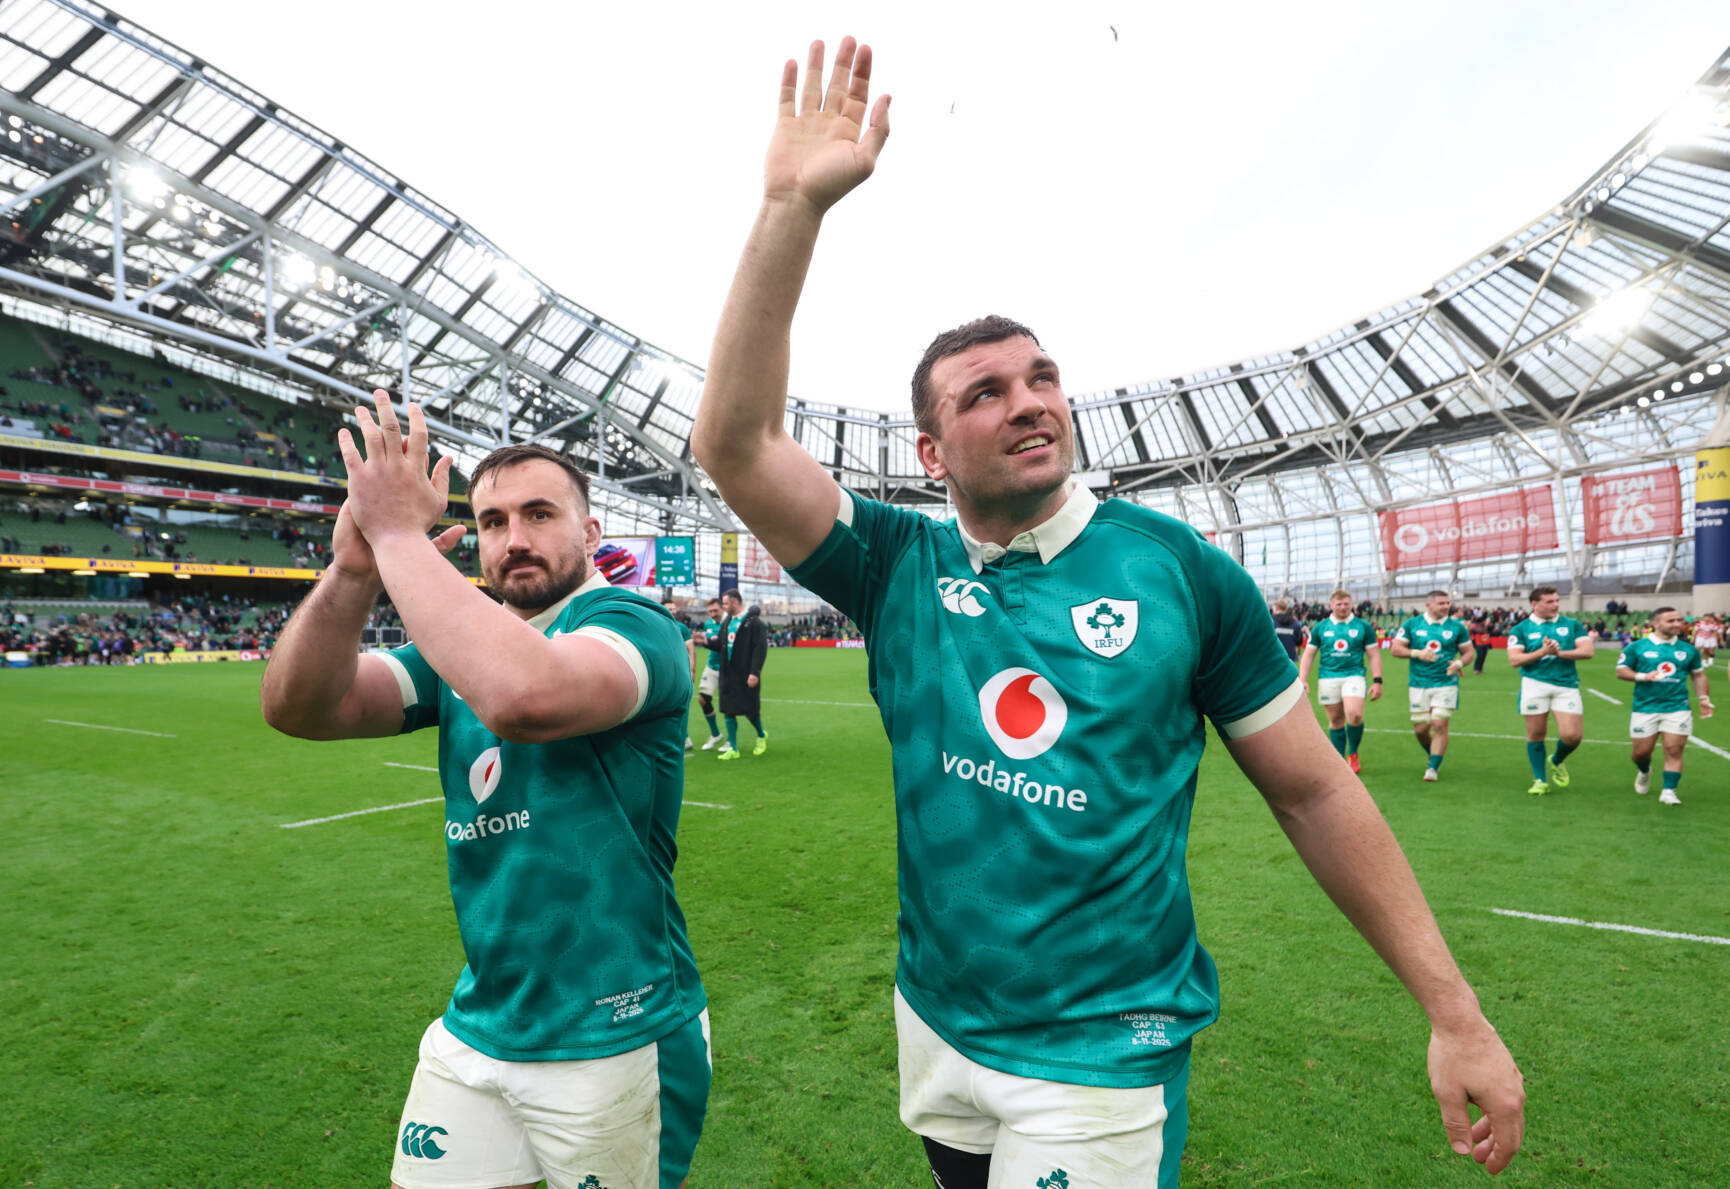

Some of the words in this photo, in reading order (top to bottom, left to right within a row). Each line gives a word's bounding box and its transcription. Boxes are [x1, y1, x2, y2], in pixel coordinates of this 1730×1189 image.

[1696, 471, 1728, 481] IVA
[1610, 503, 1656, 536] US
[1433, 512, 1541, 541] vodafone
[1094, 638, 1123, 648] IRFU
[942, 751, 1088, 812] vodafone
[595, 994, 621, 1006] RONAN
[613, 999, 629, 1007] CAP
[615, 1003, 639, 1015] JAPAN
[1149, 1013, 1177, 1024] BEIRNE
[1132, 1021, 1151, 1029] CAP
[1135, 1030, 1166, 1038] JAPAN
